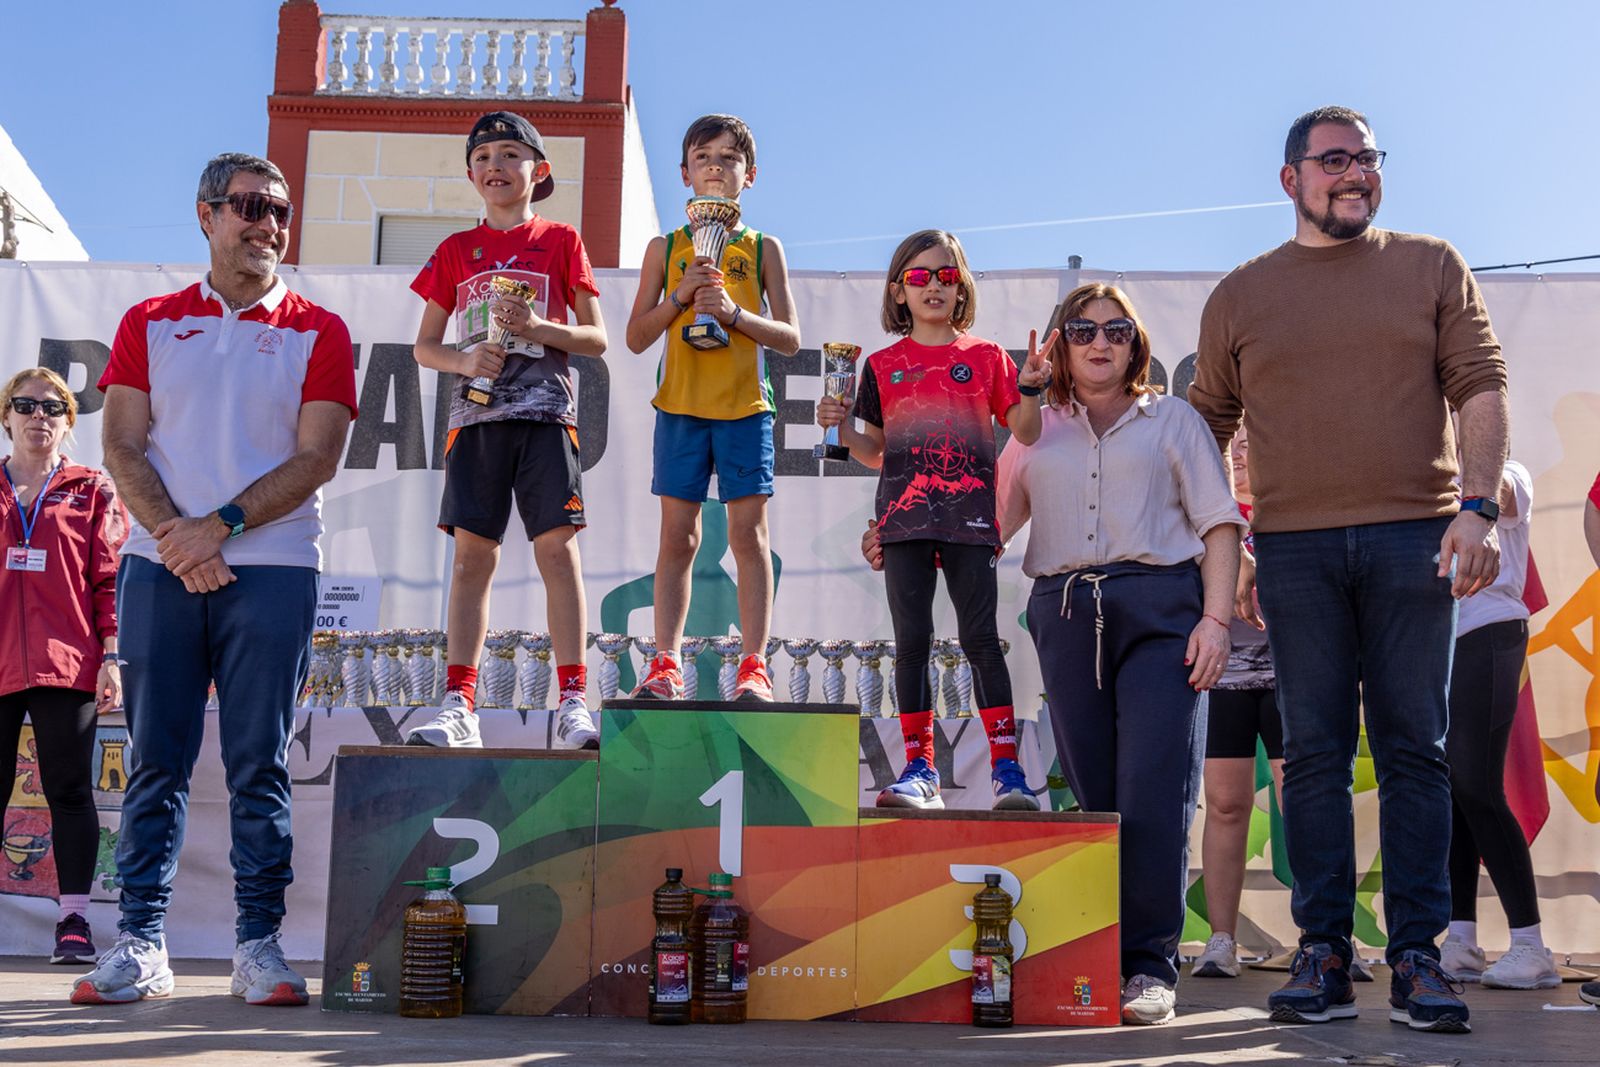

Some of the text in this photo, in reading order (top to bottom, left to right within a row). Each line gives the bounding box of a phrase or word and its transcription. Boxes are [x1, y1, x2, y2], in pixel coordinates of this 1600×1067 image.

[467, 280, 478, 297] X
[338, 615, 348, 627] €
[699, 770, 744, 877] 1
[433, 818, 500, 925] 2
[949, 864, 1028, 972] 3
[601, 963, 848, 977] CONC DEPORTES
